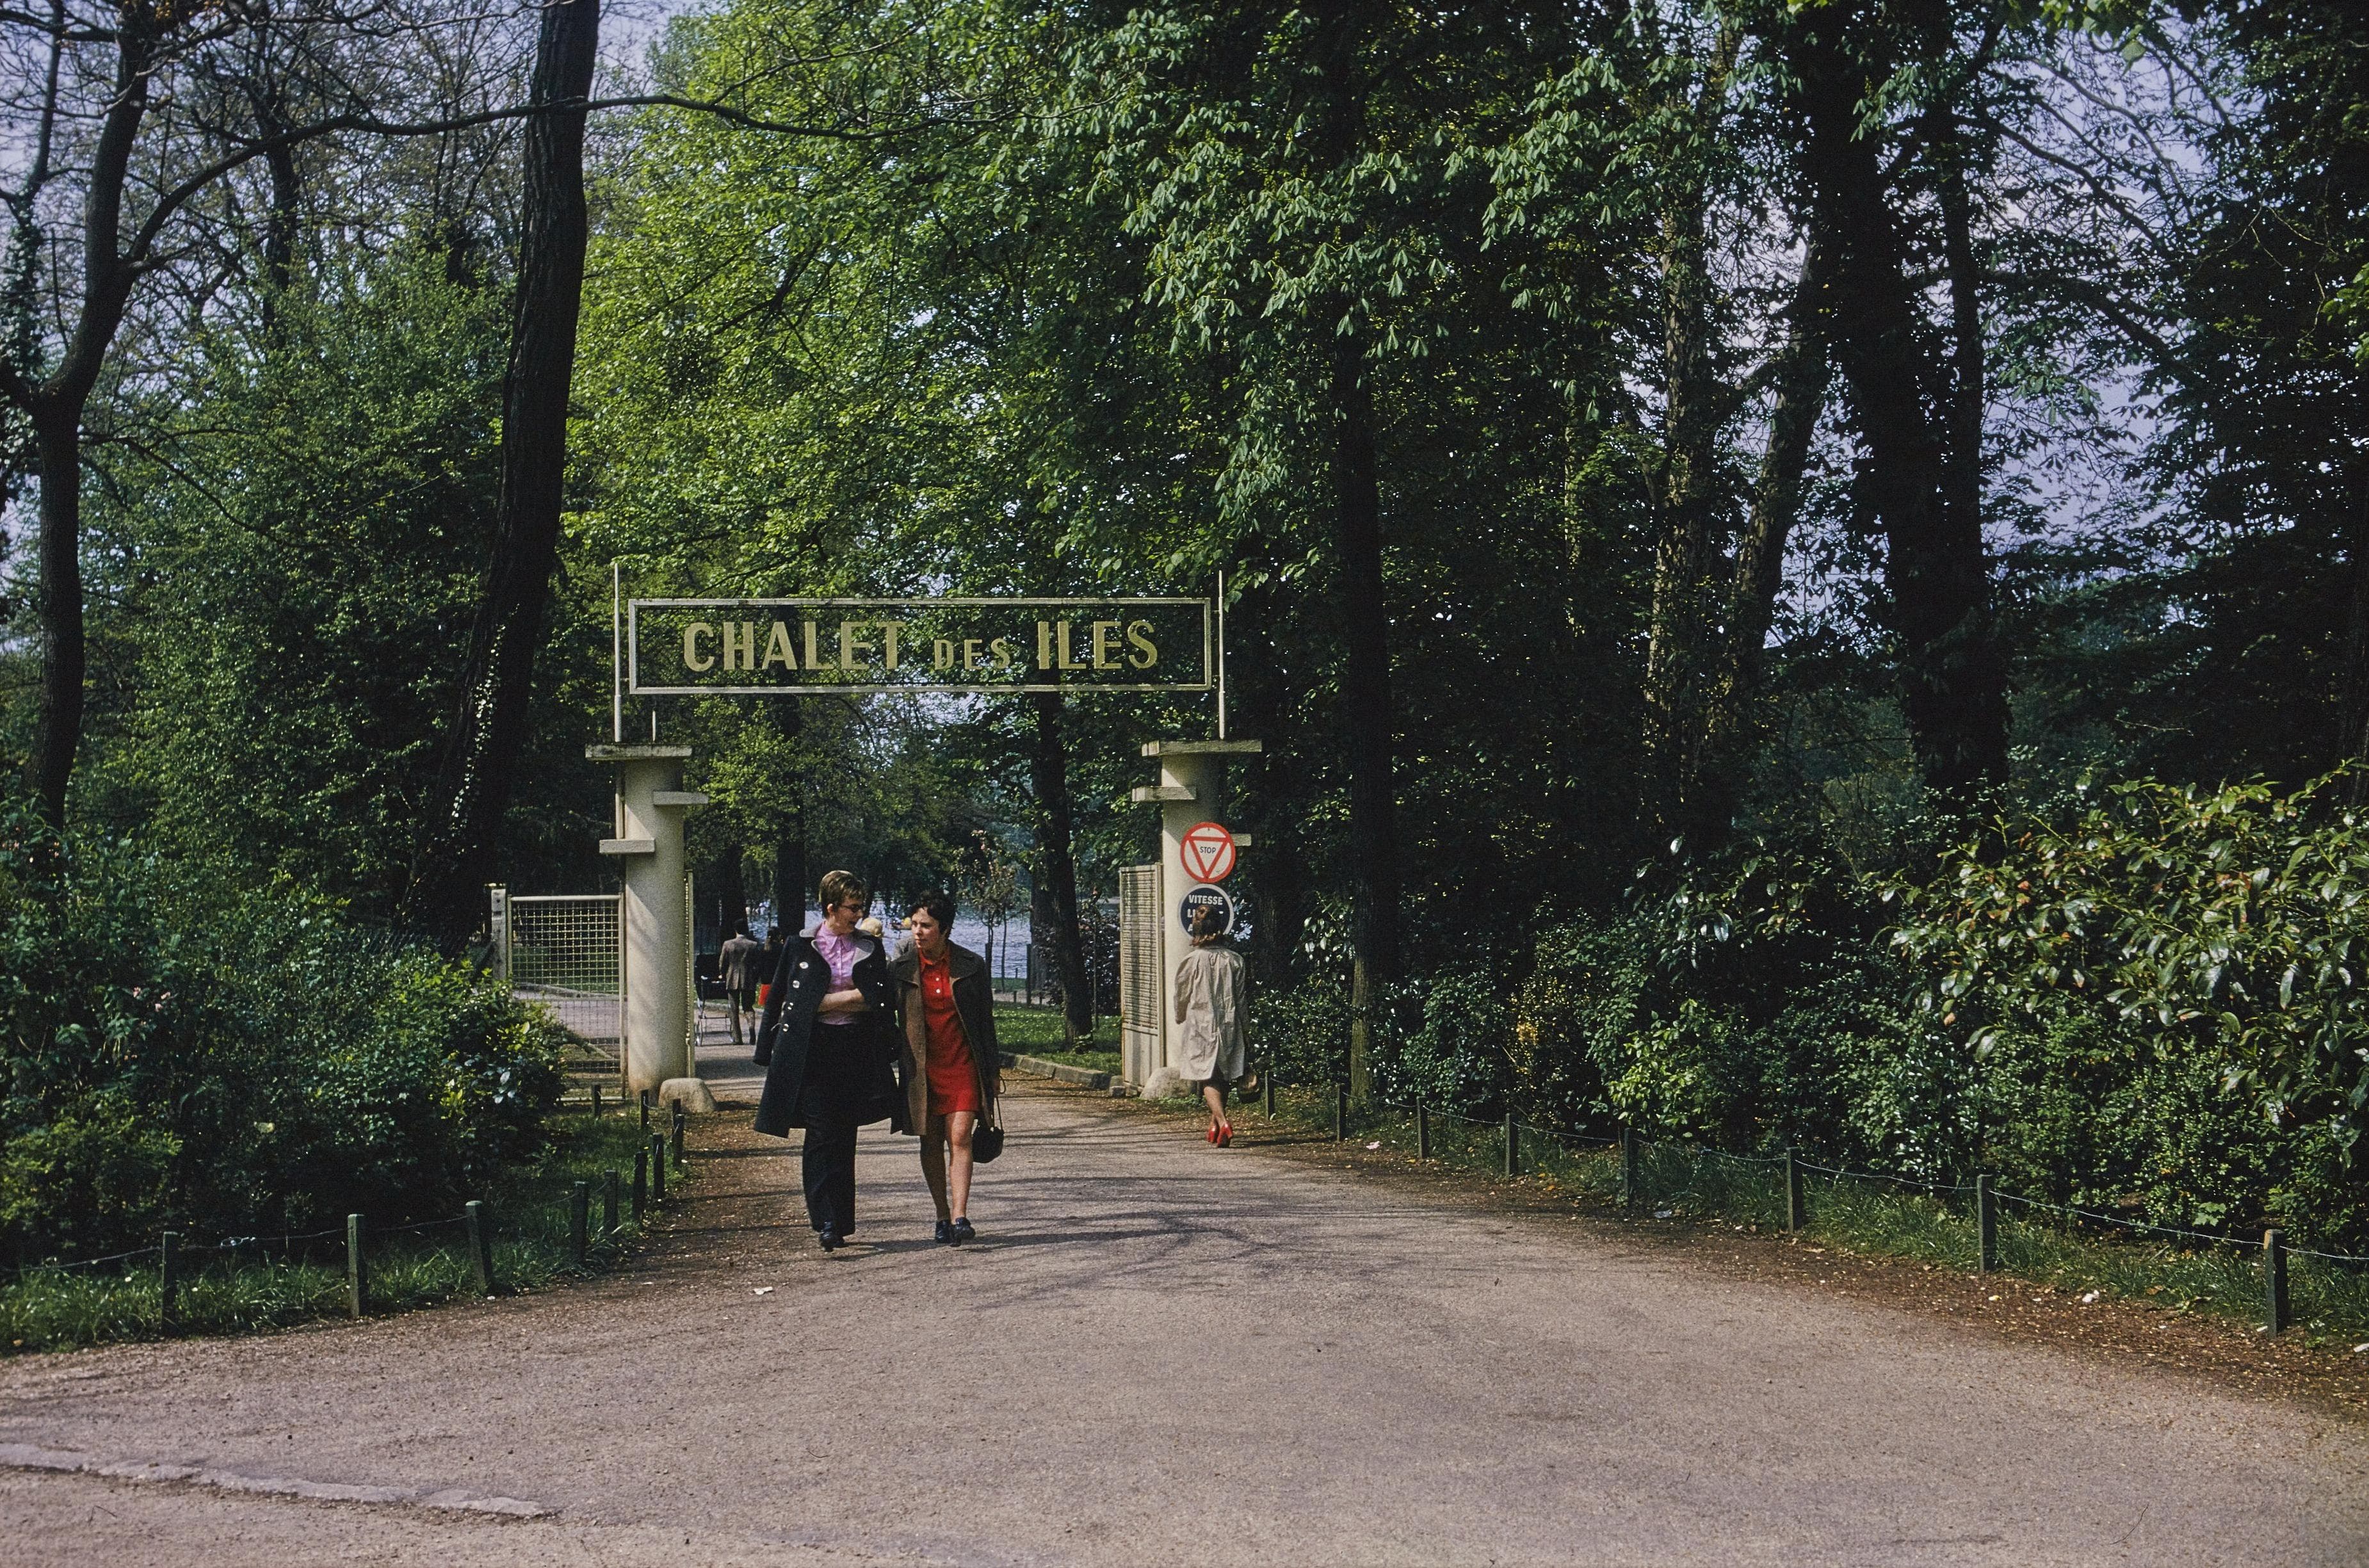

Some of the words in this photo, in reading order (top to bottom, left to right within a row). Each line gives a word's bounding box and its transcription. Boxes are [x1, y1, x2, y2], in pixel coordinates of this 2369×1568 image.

[684, 621, 906, 672] CHALET
[934, 638, 1010, 670] DES
[1037, 620, 1158, 670] ILES
[1199, 846, 1217, 854] STOP
[1188, 894, 1223, 905] VITESSE
